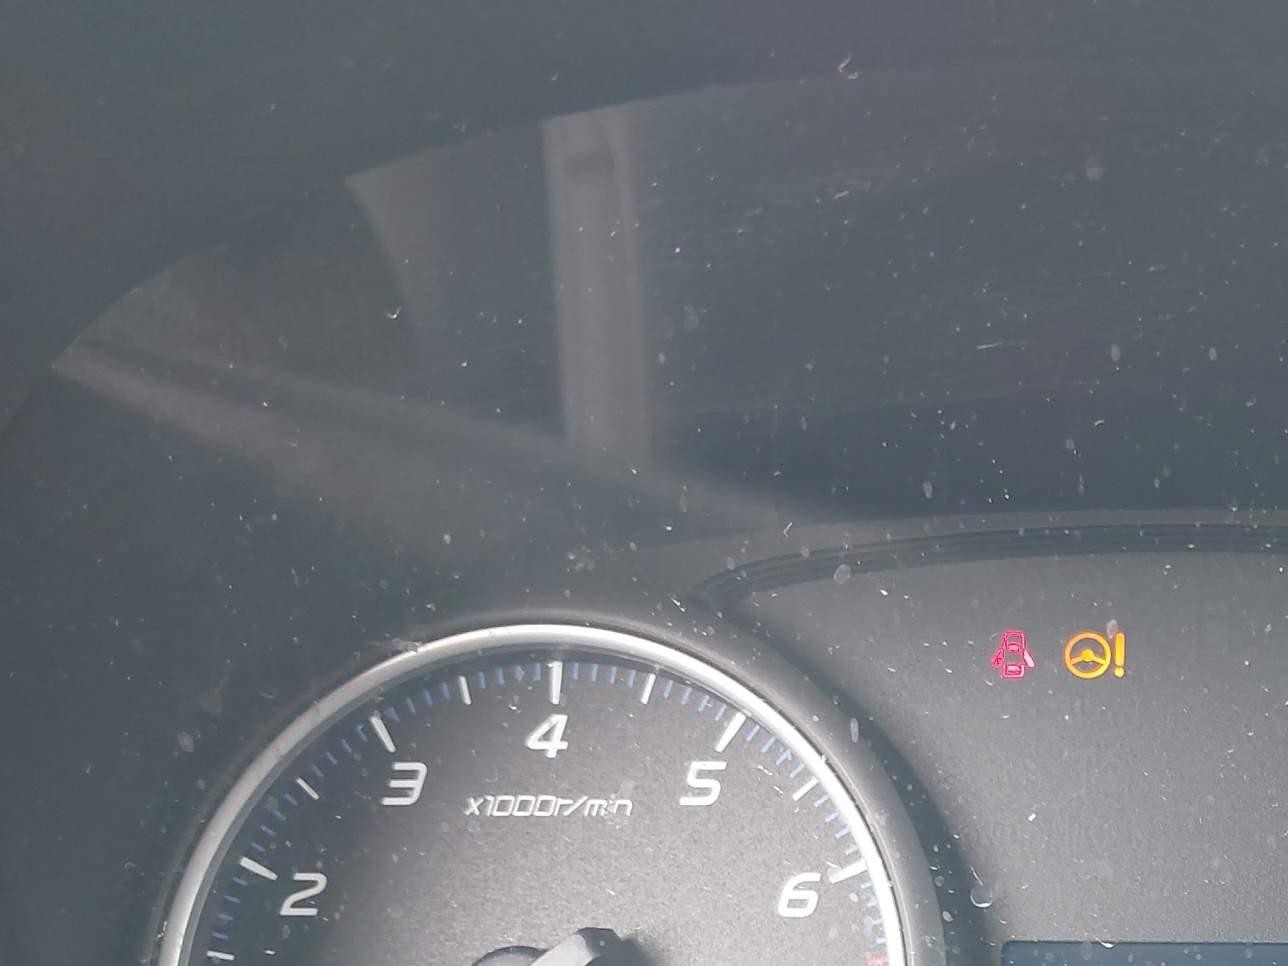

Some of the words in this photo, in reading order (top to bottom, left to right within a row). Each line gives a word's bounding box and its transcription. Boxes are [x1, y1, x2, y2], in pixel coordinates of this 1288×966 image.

[527, 714, 568, 758] 4
[382, 762, 427, 806] 3
[680, 761, 726, 806] 5
[280, 873, 328, 916] 2
[777, 873, 820, 917] 6
